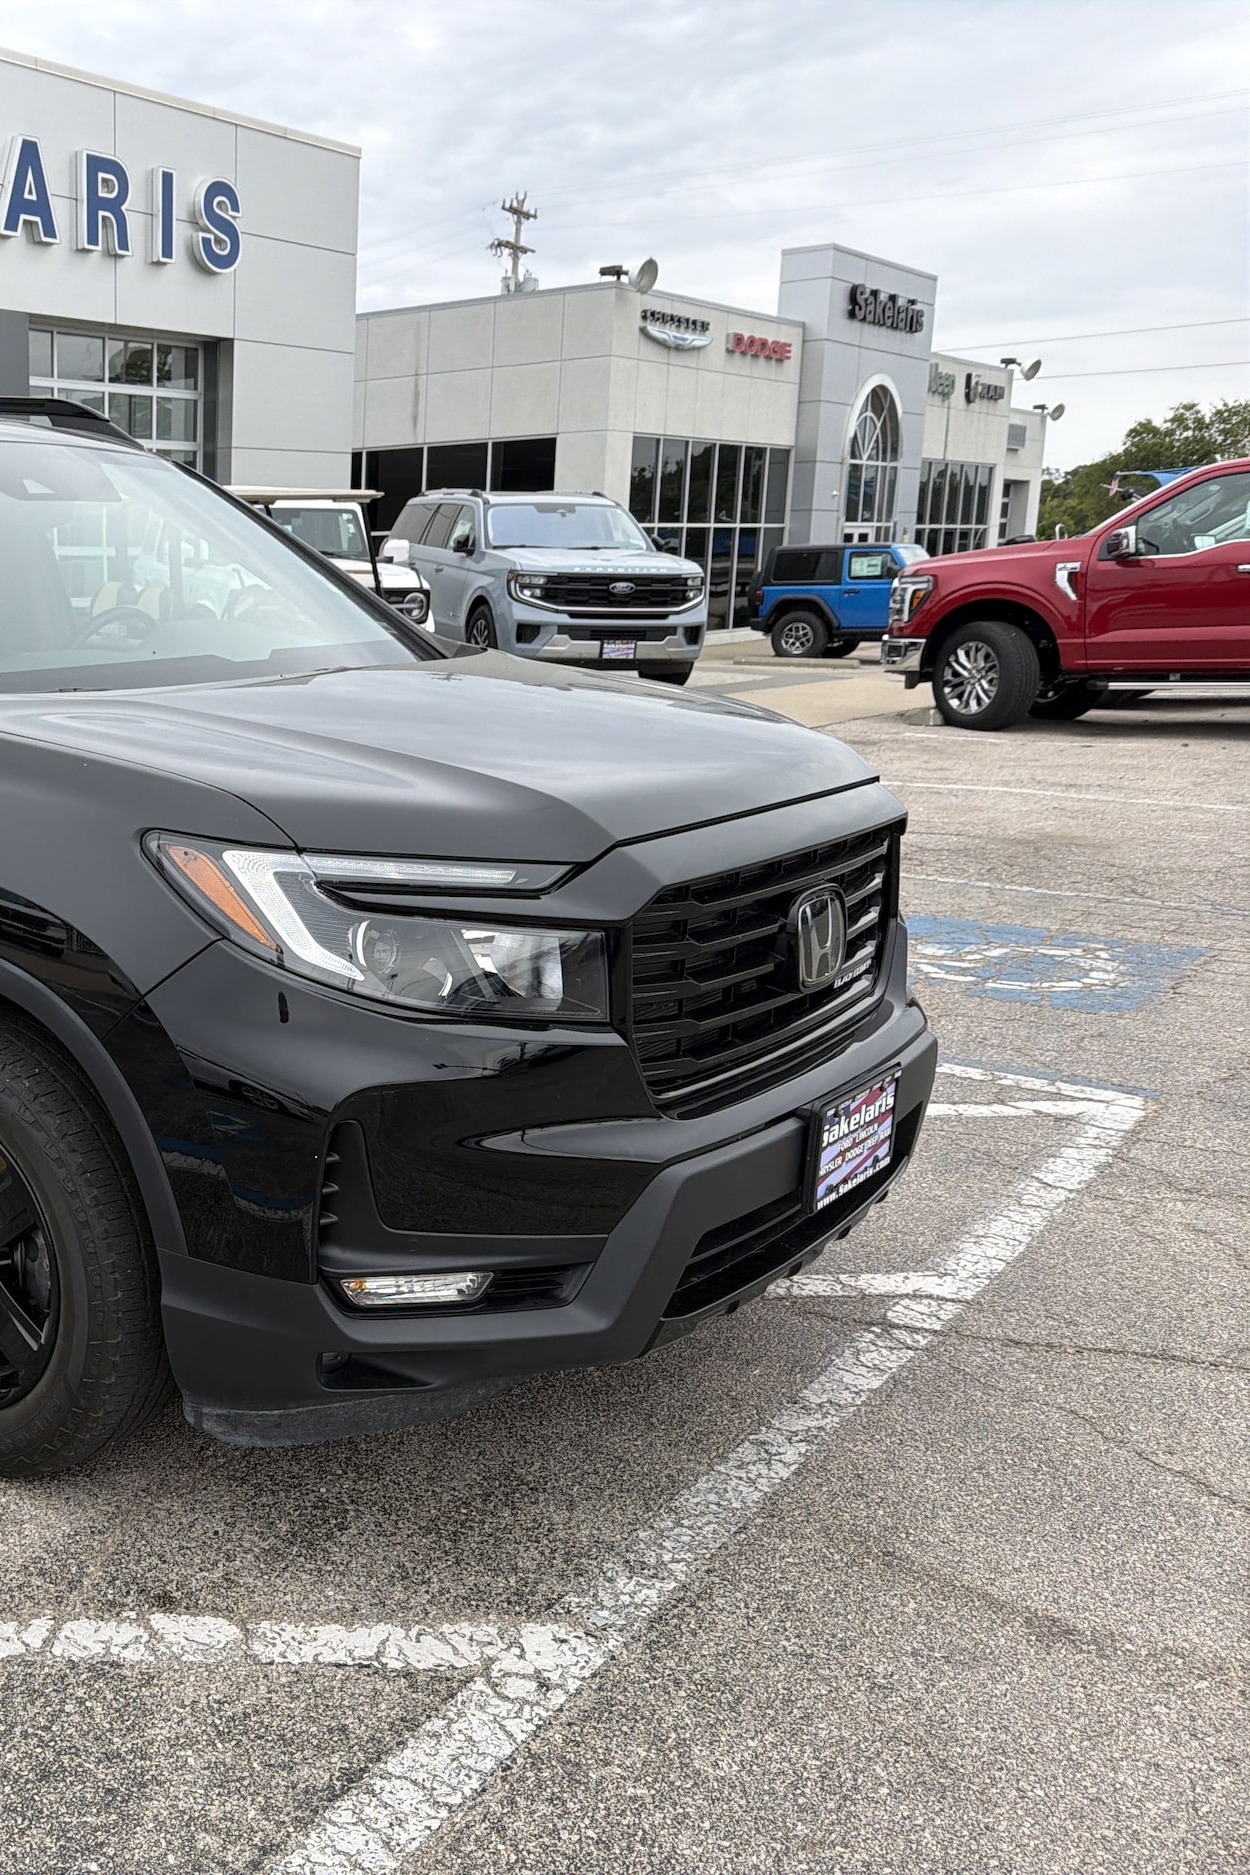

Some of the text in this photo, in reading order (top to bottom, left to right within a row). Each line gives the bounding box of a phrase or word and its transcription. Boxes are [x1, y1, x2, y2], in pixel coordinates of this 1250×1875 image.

[848, 283, 925, 333] Sakelaris
[726, 332, 793, 361] DODGE
[928, 363, 955, 400] Jeep
[845, 1143, 865, 1161] DODGE
